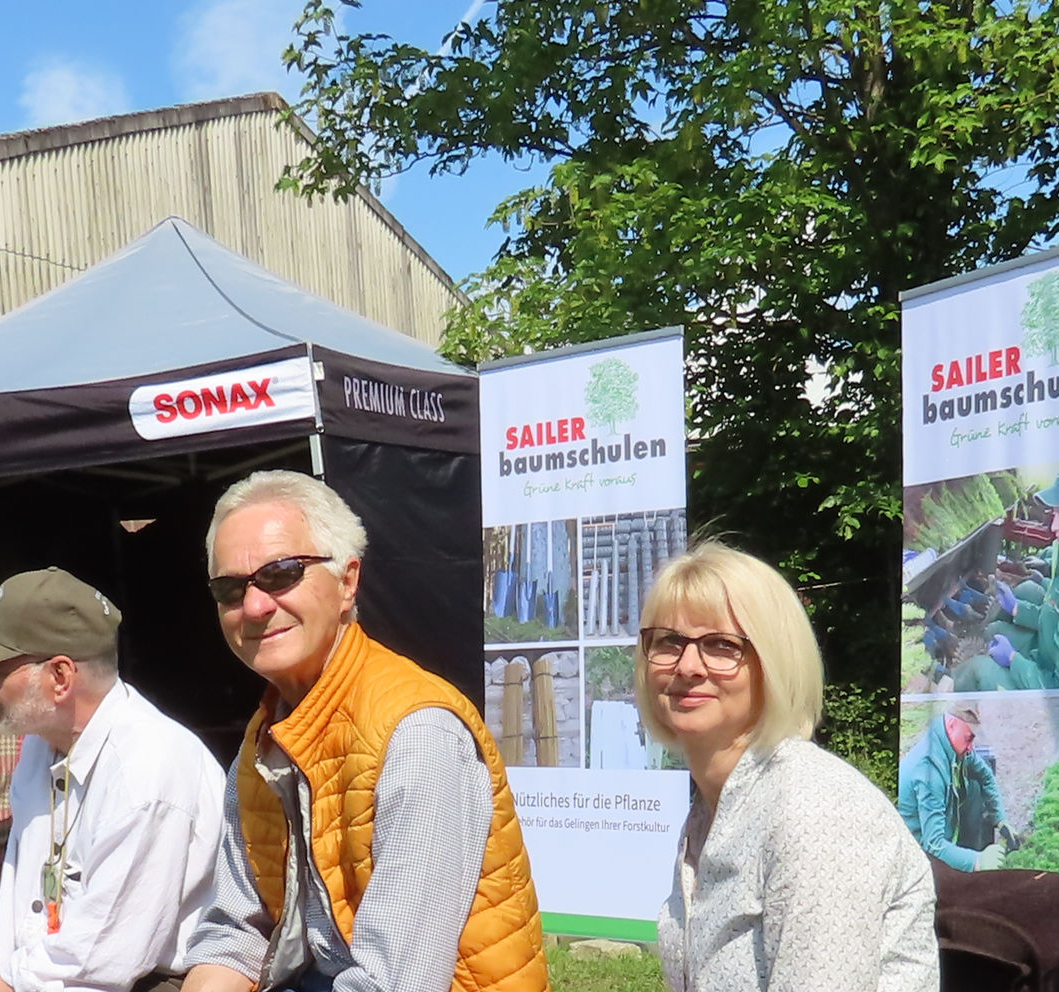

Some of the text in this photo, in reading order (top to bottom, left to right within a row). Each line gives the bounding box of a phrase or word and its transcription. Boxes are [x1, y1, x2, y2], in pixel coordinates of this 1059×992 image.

[931, 346, 1022, 393] SAILER
[153, 378, 277, 424] SONAX
[344, 376, 446, 423] PREMIUM CLASS
[922, 370, 1059, 426] baumschu
[506, 417, 587, 450] SAILER
[950, 426, 991, 448] Grüne
[998, 412, 1030, 438] Kraft
[499, 434, 667, 477] baumschulen
[524, 472, 637, 497] Grüne Kraft voraus
[573, 791, 590, 809] für
[593, 793, 612, 810] die
[615, 794, 661, 811] Pflanze
[536, 816, 548, 828] für
[549, 817, 563, 829] das
[564, 818, 600, 832] Gelingen
[601, 818, 621, 831] Ihrer
[623, 820, 670, 833] Forstkultur
